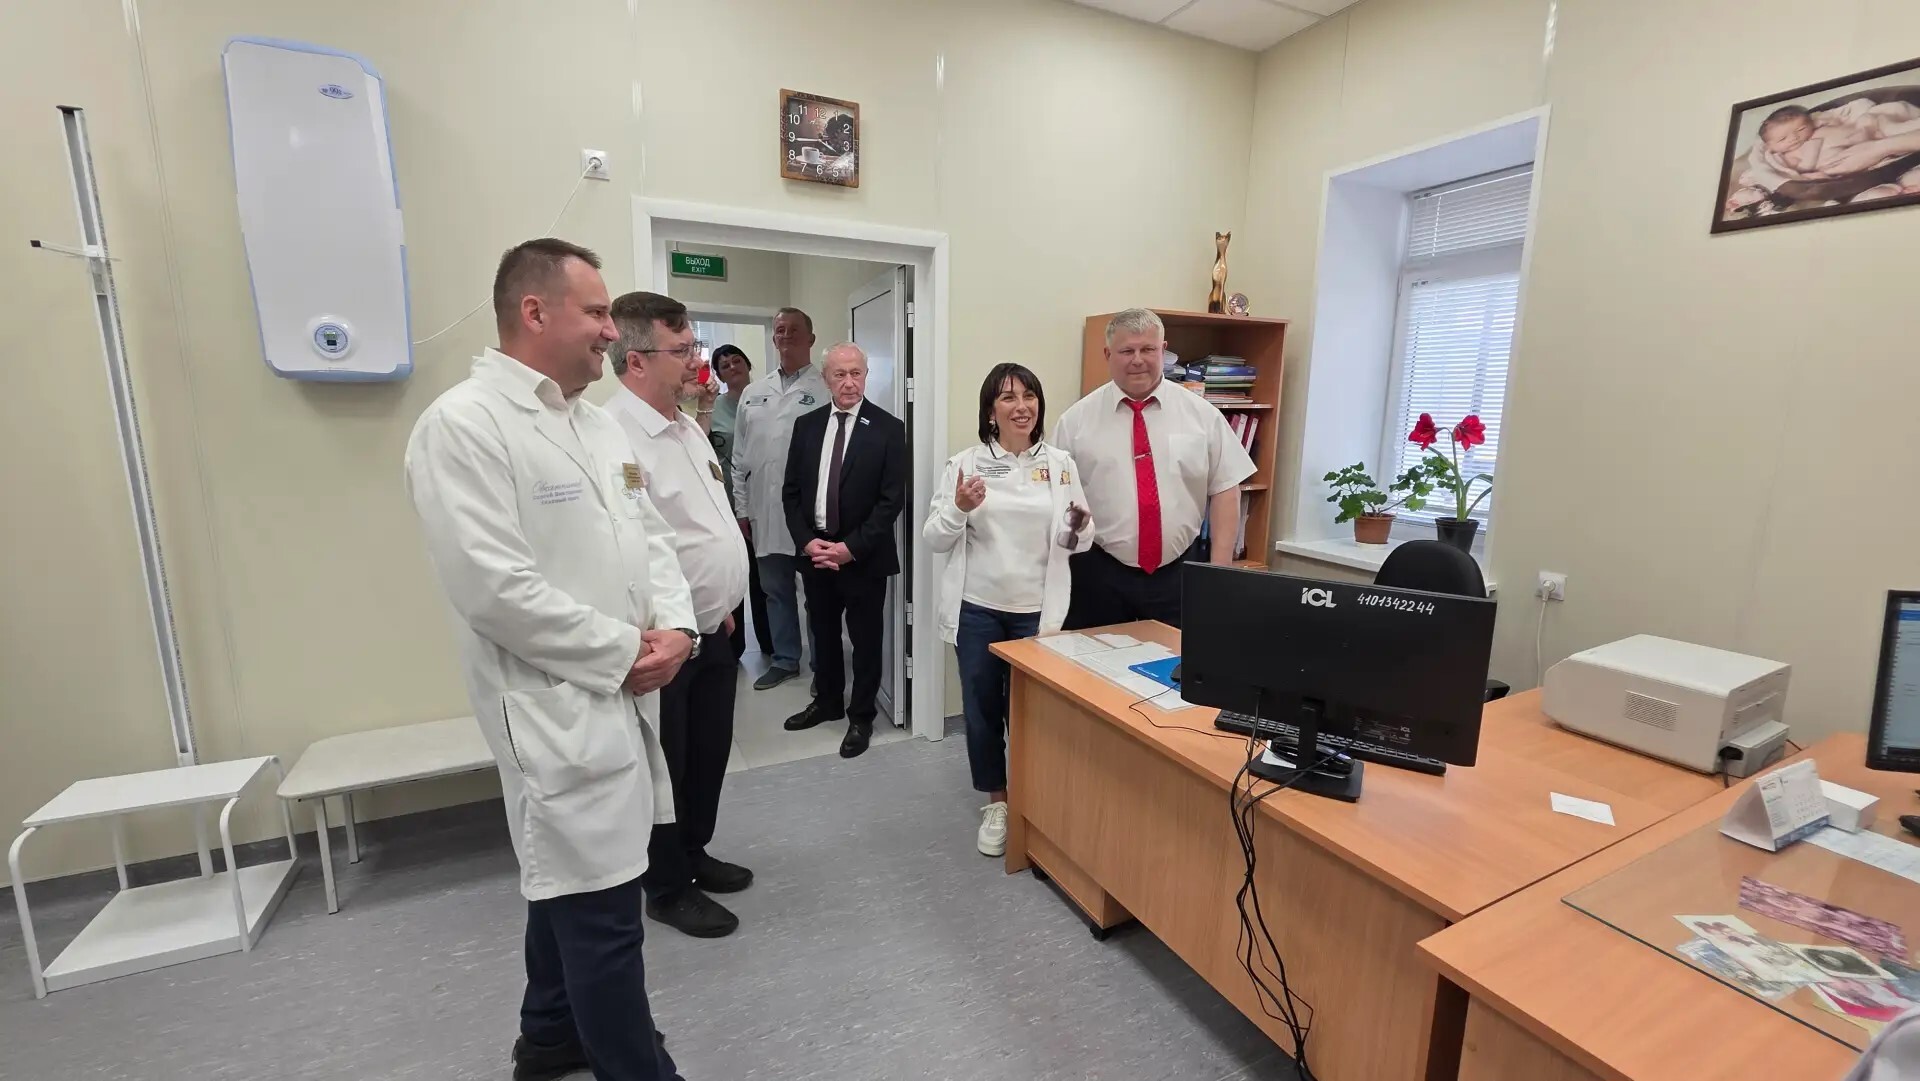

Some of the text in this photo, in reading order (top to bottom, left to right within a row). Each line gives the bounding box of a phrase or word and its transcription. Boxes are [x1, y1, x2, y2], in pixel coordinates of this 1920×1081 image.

[799, 104, 808, 115] 11
[815, 107, 826, 119] 12
[788, 114, 800, 125] 10
[833, 110, 839, 121] 1
[843, 123, 850, 134] 2
[788, 132, 796, 142] 9
[843, 141, 850, 151] 3
[788, 149, 796, 160] 8
[800, 162, 807, 173] 7
[816, 164, 823, 175] 6
[832, 167, 839, 178] 5
[685, 257, 710, 267] ВЫХОД
[1357, 593, 1435, 615] 4101342244
